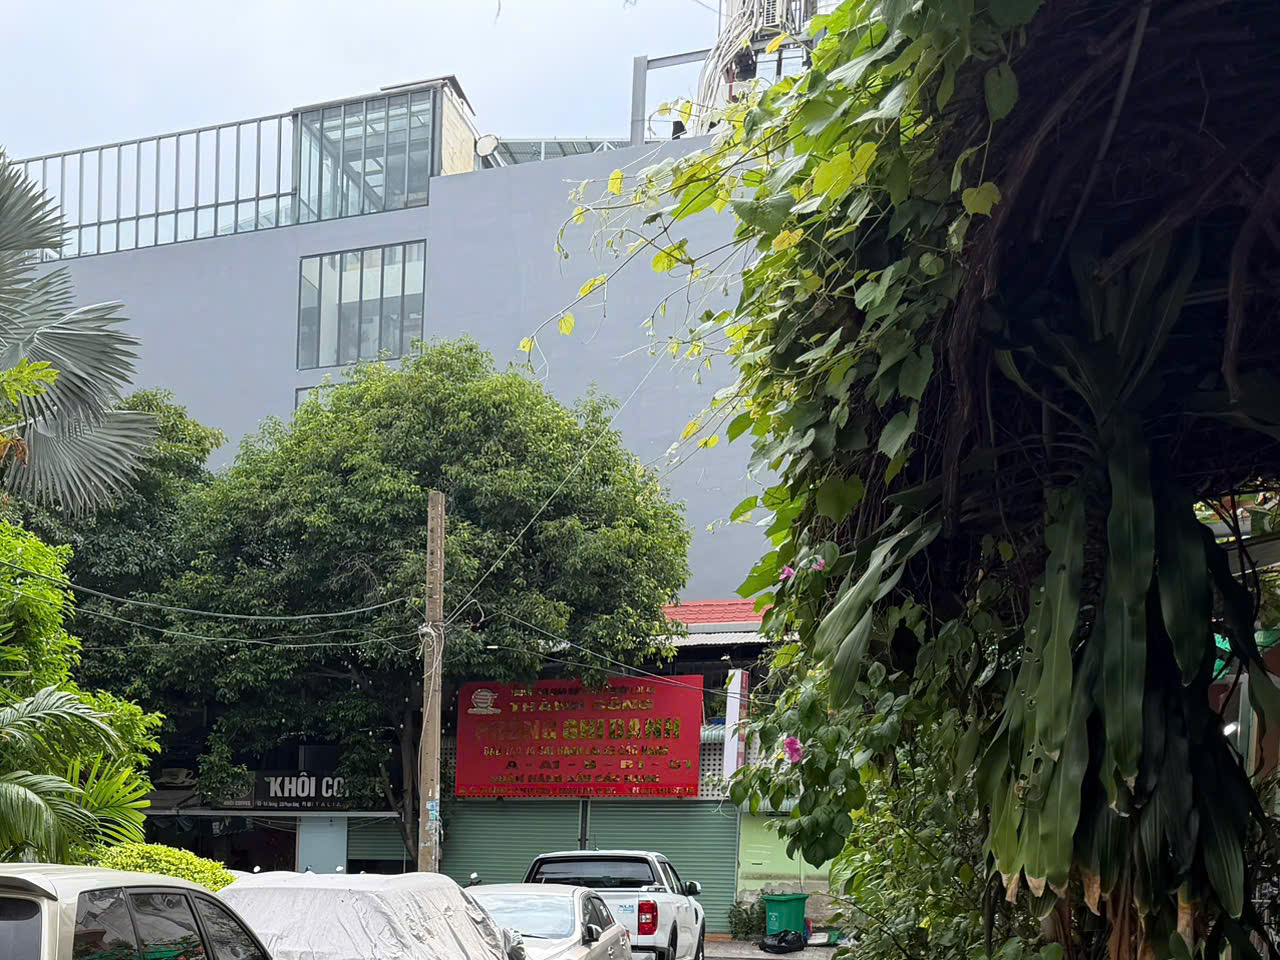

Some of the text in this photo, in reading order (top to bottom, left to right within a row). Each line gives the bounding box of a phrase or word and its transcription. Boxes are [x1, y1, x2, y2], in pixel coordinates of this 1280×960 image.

[563, 717, 605, 740] GHI
[608, 717, 681, 740] DANH
[269, 772, 317, 798] KHÔI
